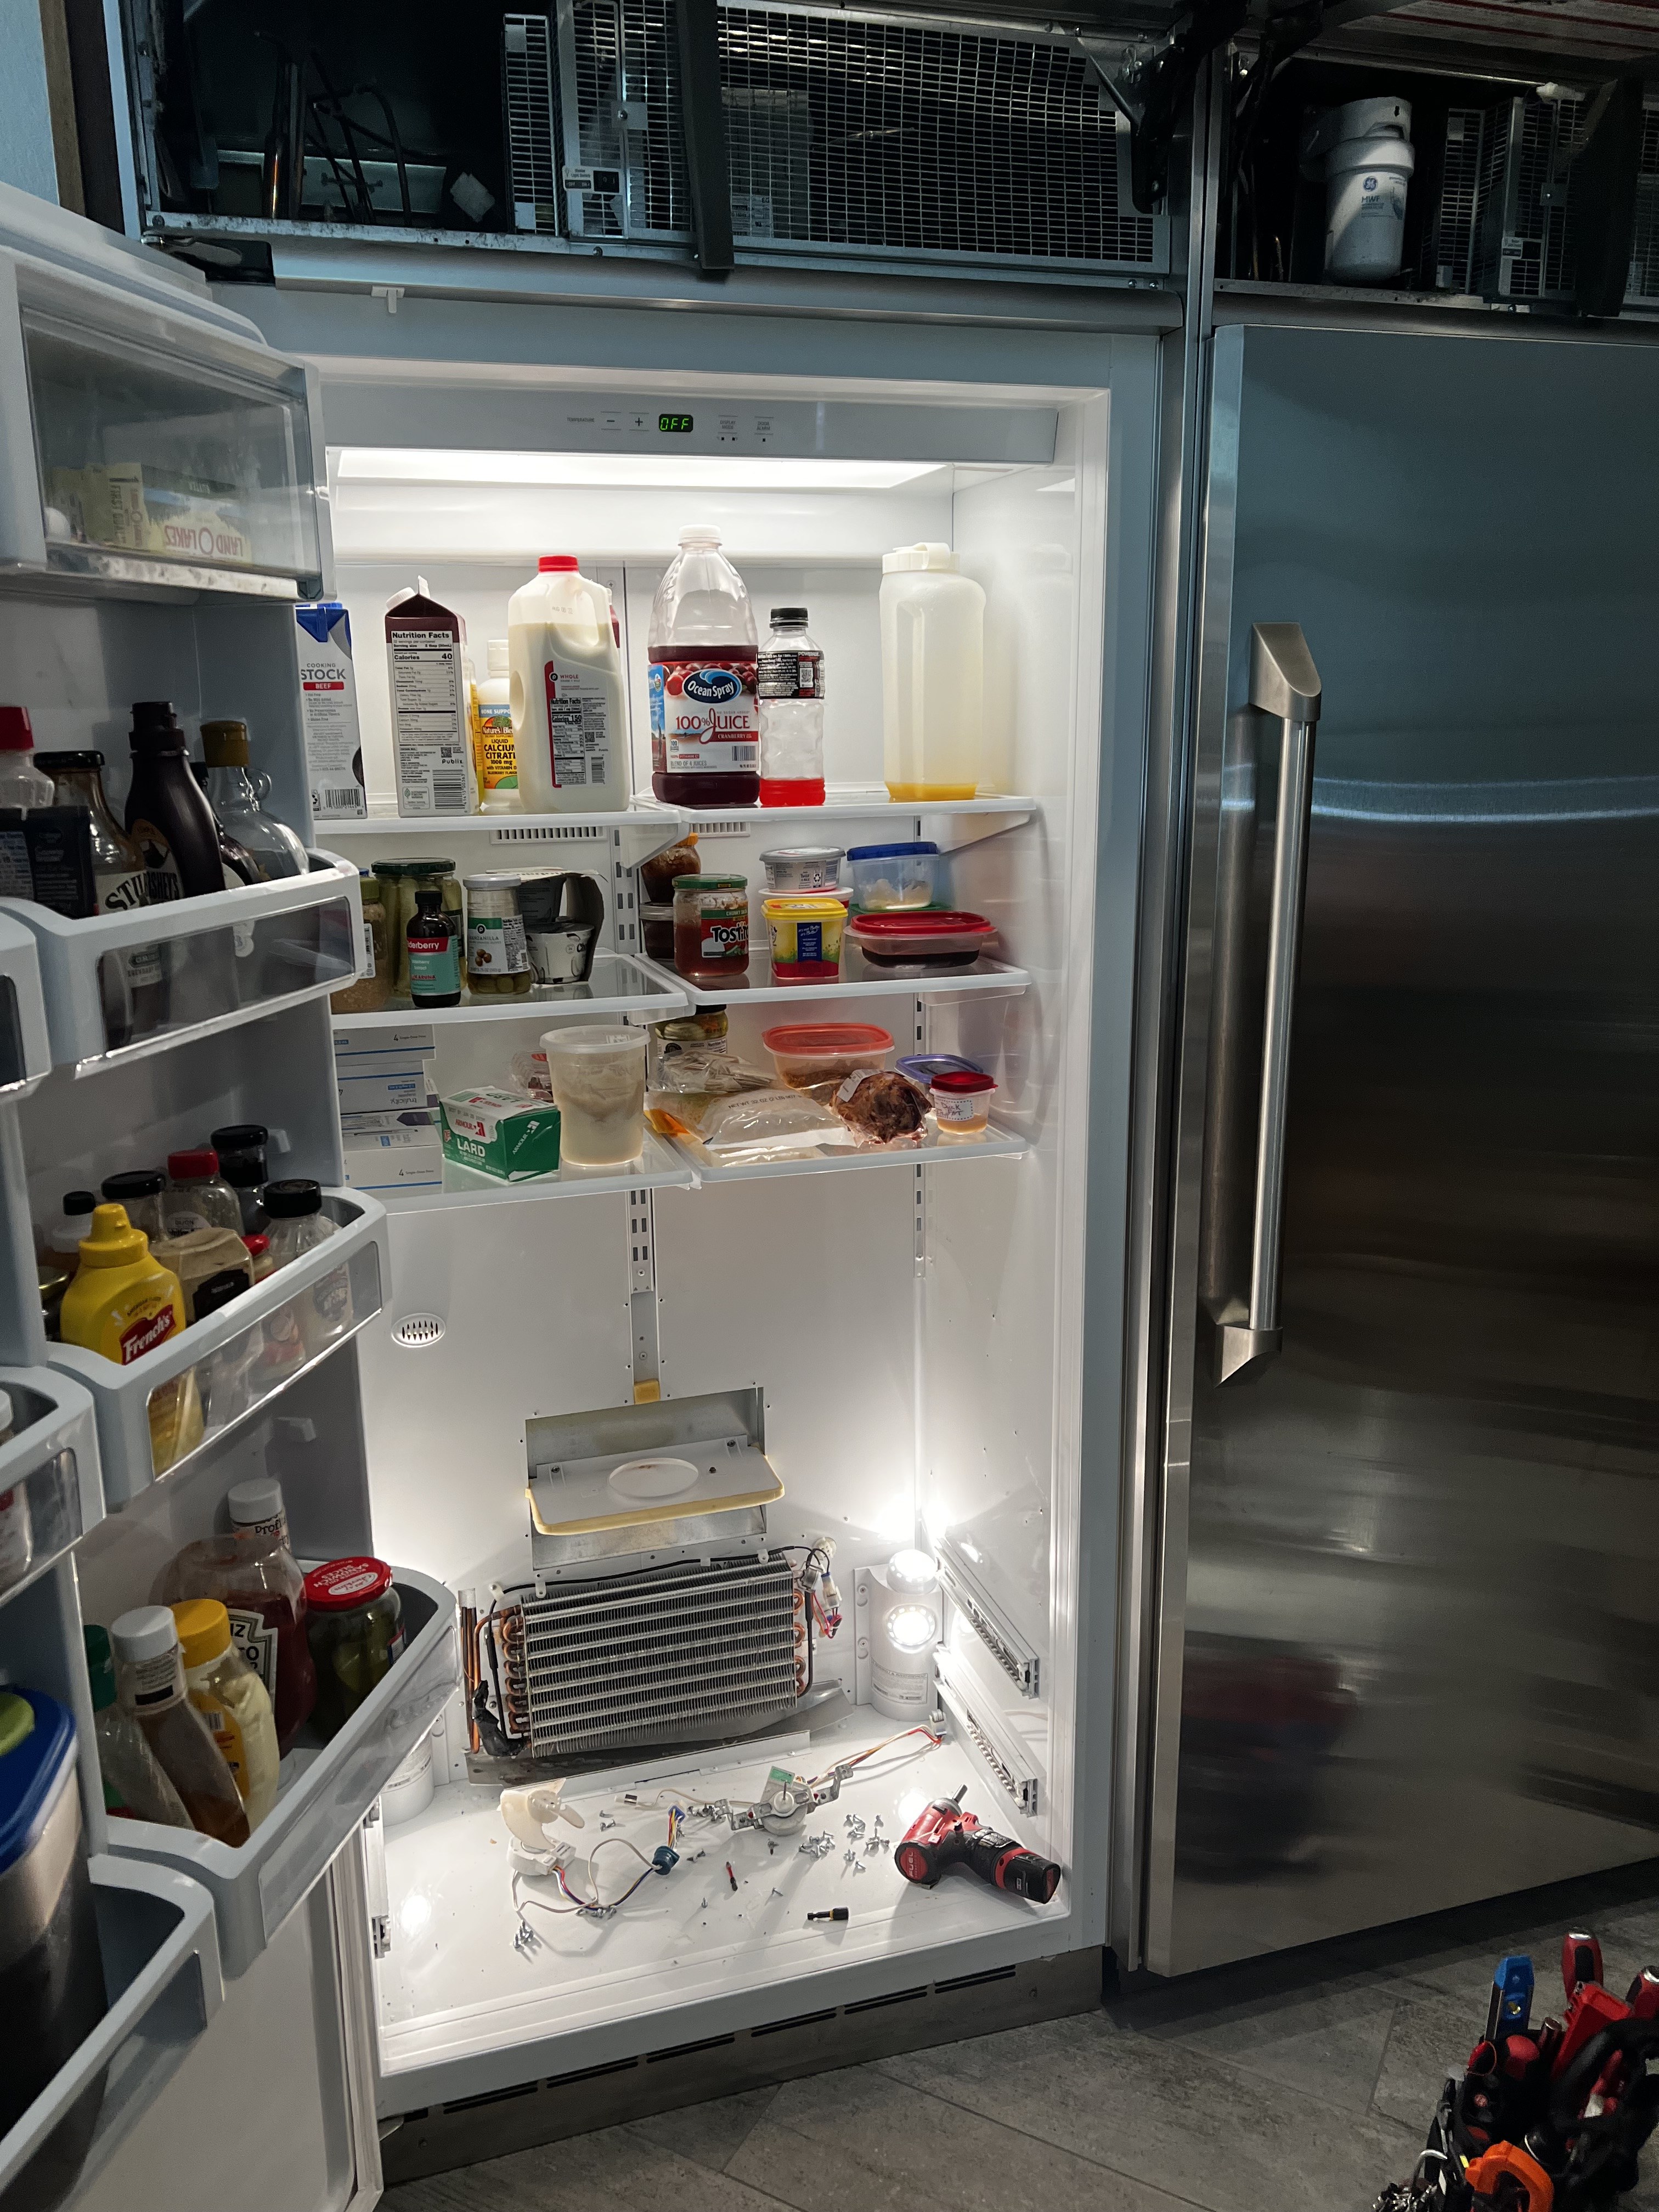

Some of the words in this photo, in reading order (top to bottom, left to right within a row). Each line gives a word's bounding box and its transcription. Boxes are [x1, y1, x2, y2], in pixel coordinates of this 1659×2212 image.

[661, 417, 689, 430] OFF
[164, 525, 196, 550] LAKES
[199, 527, 213, 555] O
[216, 534, 243, 557] LAND
[300, 669, 346, 680] STOCK
[687, 680, 712, 697] Ocean
[713, 681, 735, 699] Spray
[676, 715, 710, 730] 100%
[408, 941, 439, 950] derberry
[455, 1119, 475, 1130] ARMOUR
[456, 1138, 486, 1157] LARD
[123, 1310, 173, 1363] French's
